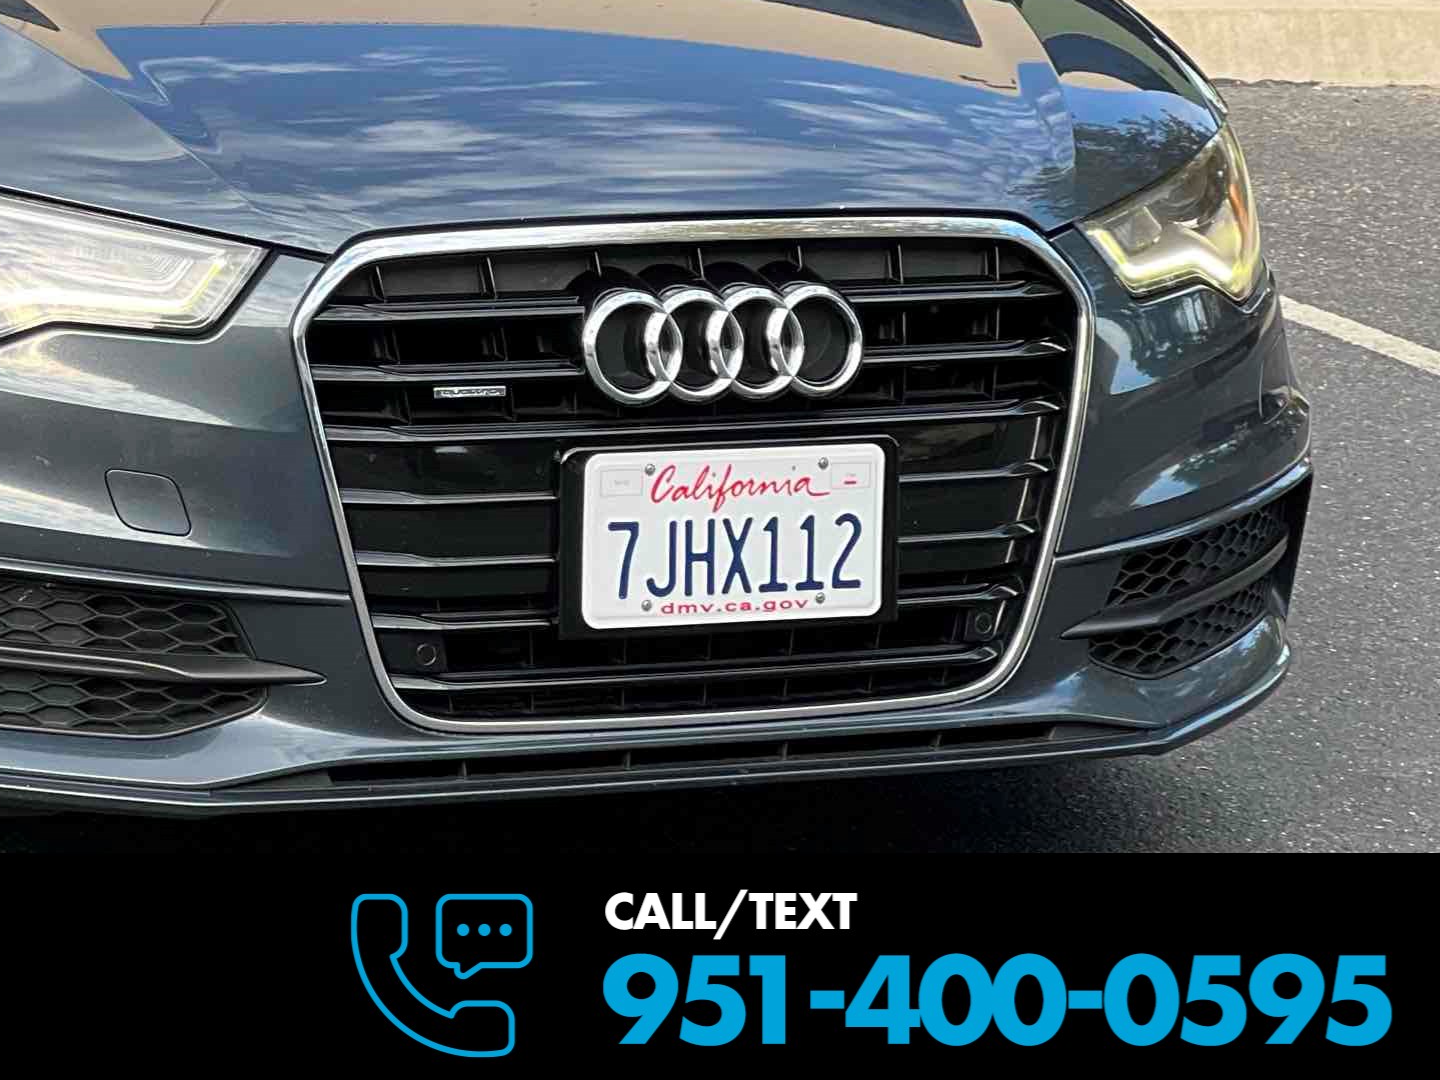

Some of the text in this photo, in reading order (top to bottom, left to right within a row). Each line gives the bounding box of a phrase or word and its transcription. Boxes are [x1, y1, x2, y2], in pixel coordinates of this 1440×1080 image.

[650, 464, 830, 512] California
[608, 513, 862, 600] 7JHX112
[661, 598, 809, 615] dmv.ca.gov
